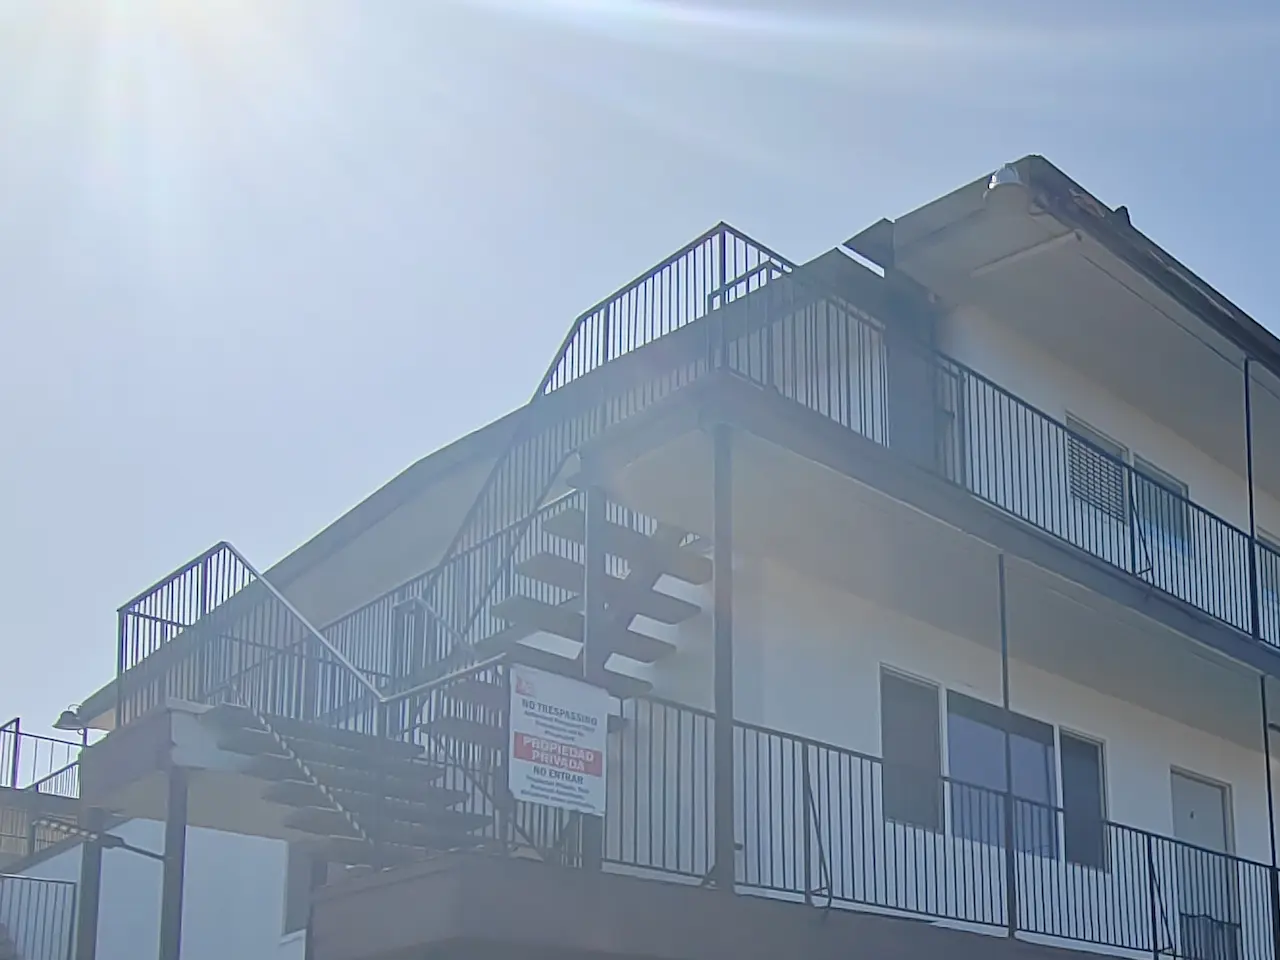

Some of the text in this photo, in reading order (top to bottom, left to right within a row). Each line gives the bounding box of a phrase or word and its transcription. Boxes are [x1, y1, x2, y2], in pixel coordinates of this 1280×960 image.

[521, 698, 535, 710] NO
[537, 702, 598, 726] TRESPASSING
[522, 735, 594, 762] PROPIEDAD
[531, 749, 585, 771] PRIVADA
[533, 765, 547, 776] NO
[549, 768, 584, 785] ENTRAR
